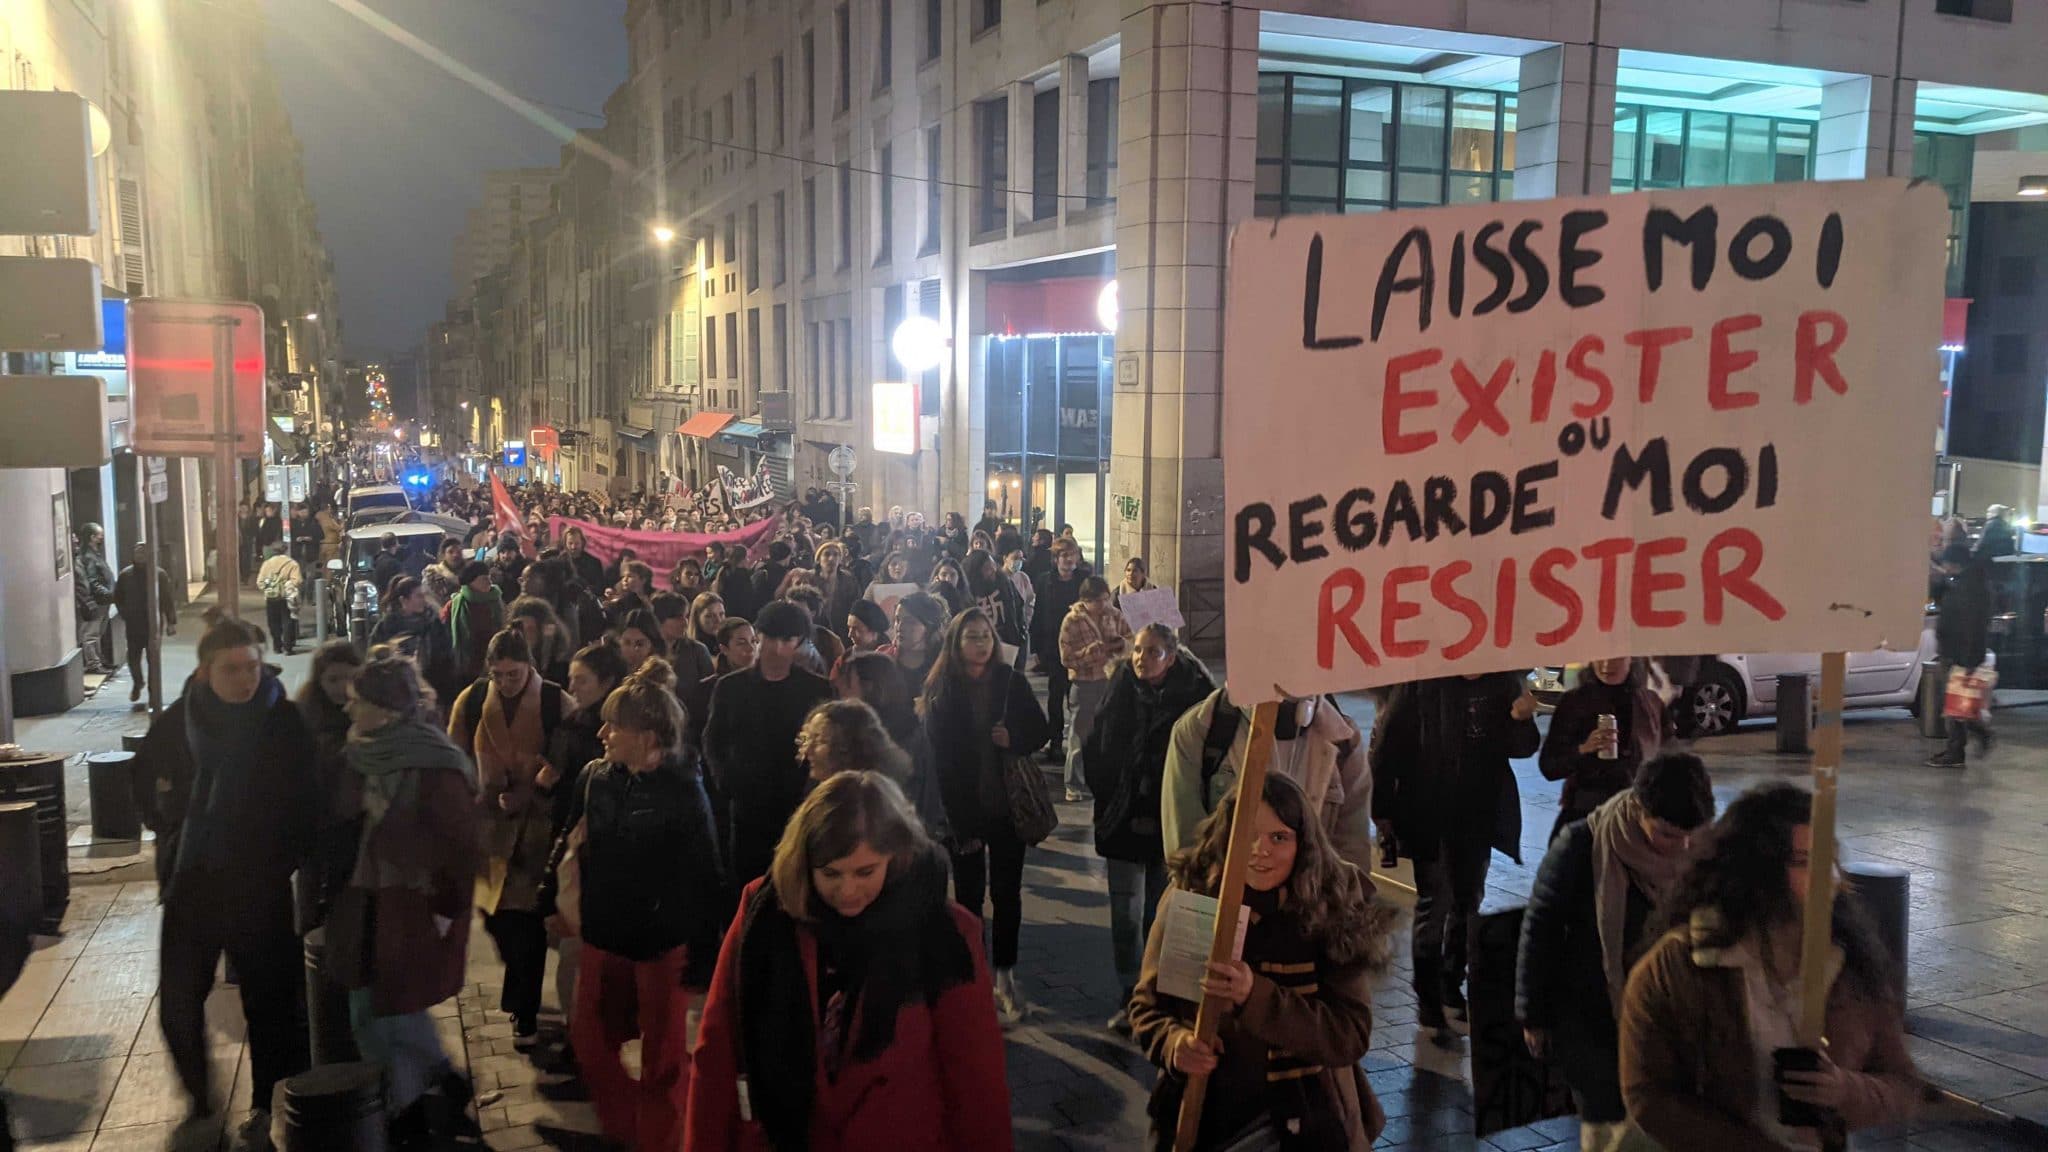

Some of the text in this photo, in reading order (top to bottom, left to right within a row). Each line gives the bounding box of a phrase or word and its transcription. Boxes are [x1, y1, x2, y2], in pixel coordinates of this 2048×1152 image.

[1302, 204, 1844, 351] LAISSE MOI
[1382, 310, 1849, 456] EXISTER
[1557, 415, 1611, 457] OU
[1233, 436, 1780, 585] REGARDE MOI
[1316, 527, 1787, 671] RESISTER
